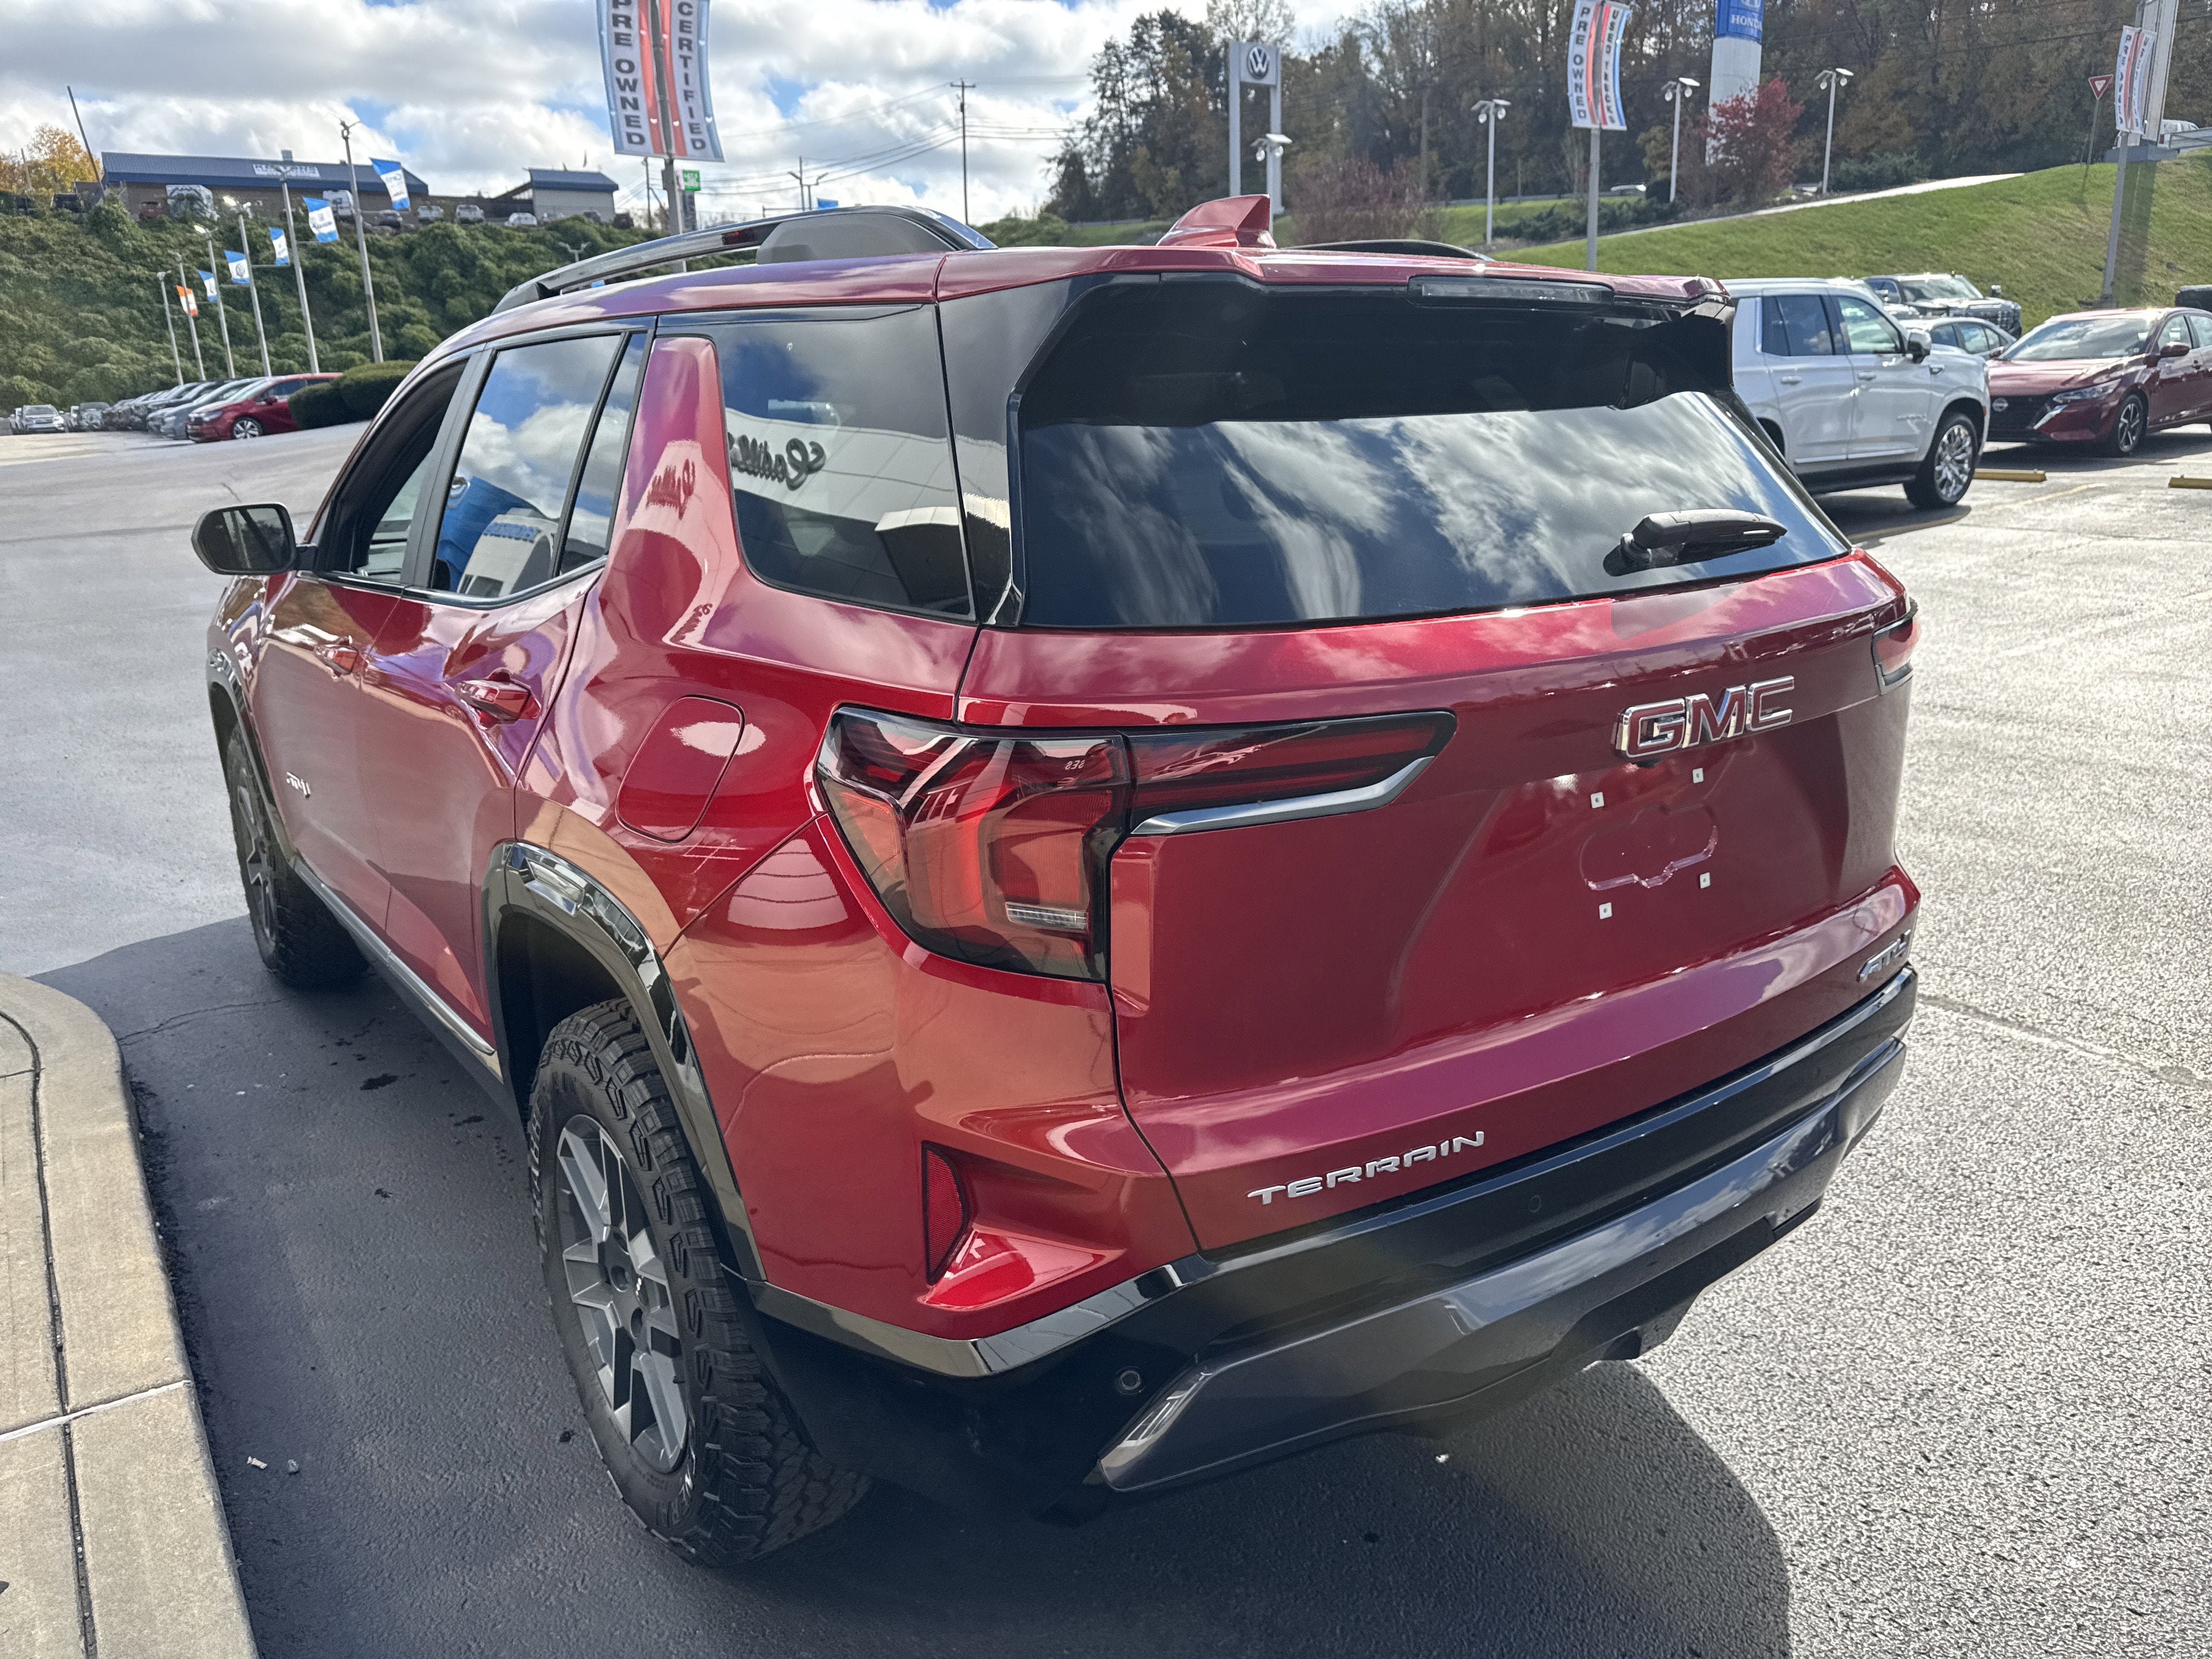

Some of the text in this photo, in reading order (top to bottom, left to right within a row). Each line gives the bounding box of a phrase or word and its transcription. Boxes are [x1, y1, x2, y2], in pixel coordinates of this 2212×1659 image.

[1572, 7, 1590, 119] PRE OWNED
[1605, 10, 1619, 54] USED
[615, 58, 646, 145] OWNED
[678, 2, 706, 150] CERTIFIED
[1616, 675, 1795, 758] GMC
[1247, 1131, 1485, 1205] TERRAIN
